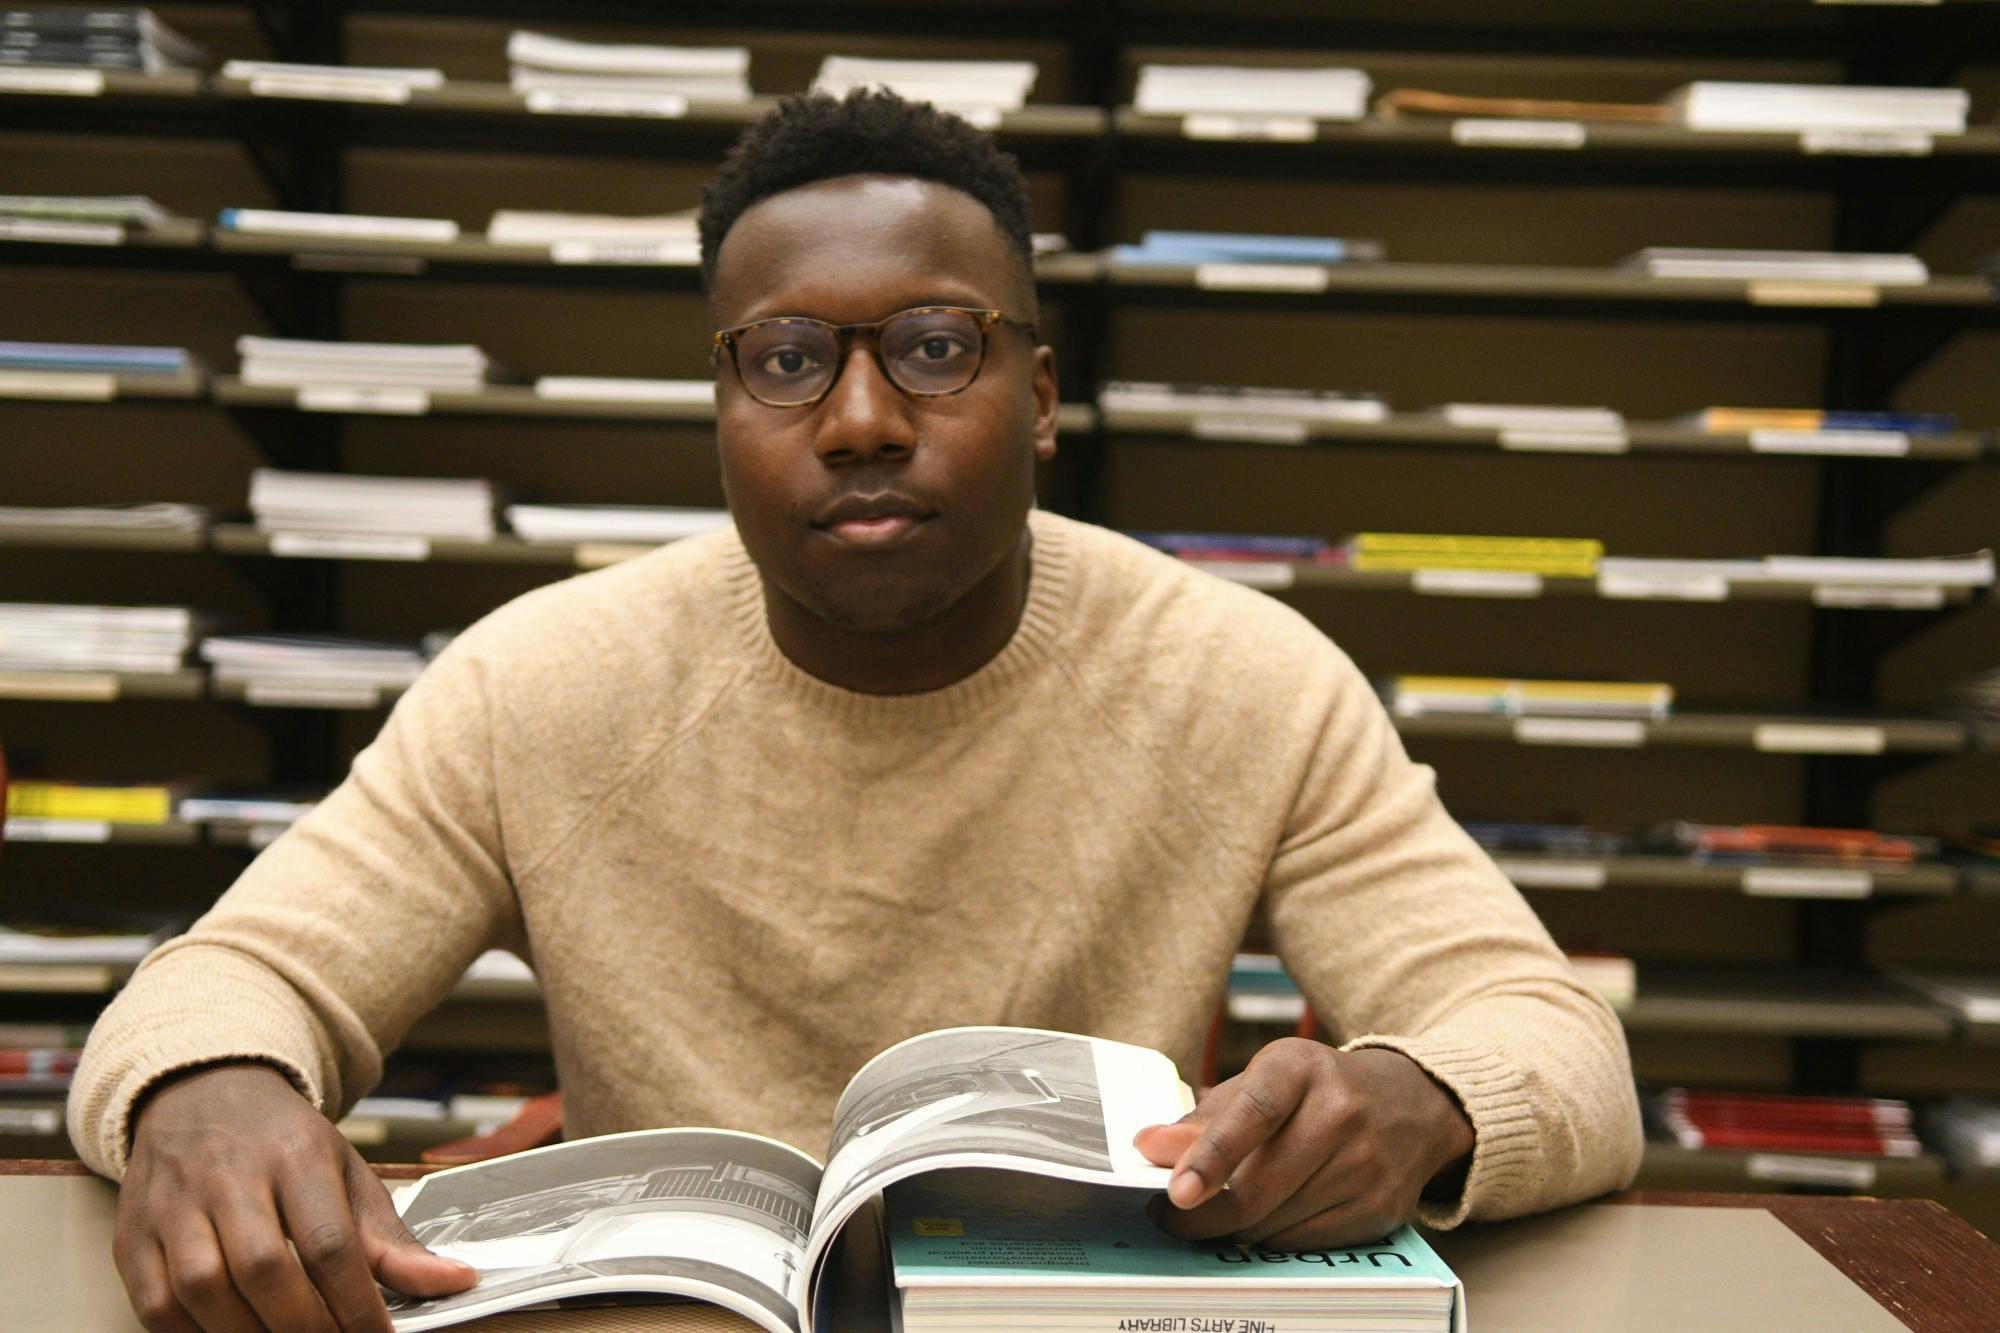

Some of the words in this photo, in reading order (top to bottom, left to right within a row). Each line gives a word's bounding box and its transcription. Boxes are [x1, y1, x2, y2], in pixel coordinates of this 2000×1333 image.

[1215, 1250, 1413, 1267] Urban
[1118, 1317, 1187, 1332] LIBRARY
[1190, 1317, 1236, 1333] ARTS
[1238, 1319, 1276, 1333] FINE
